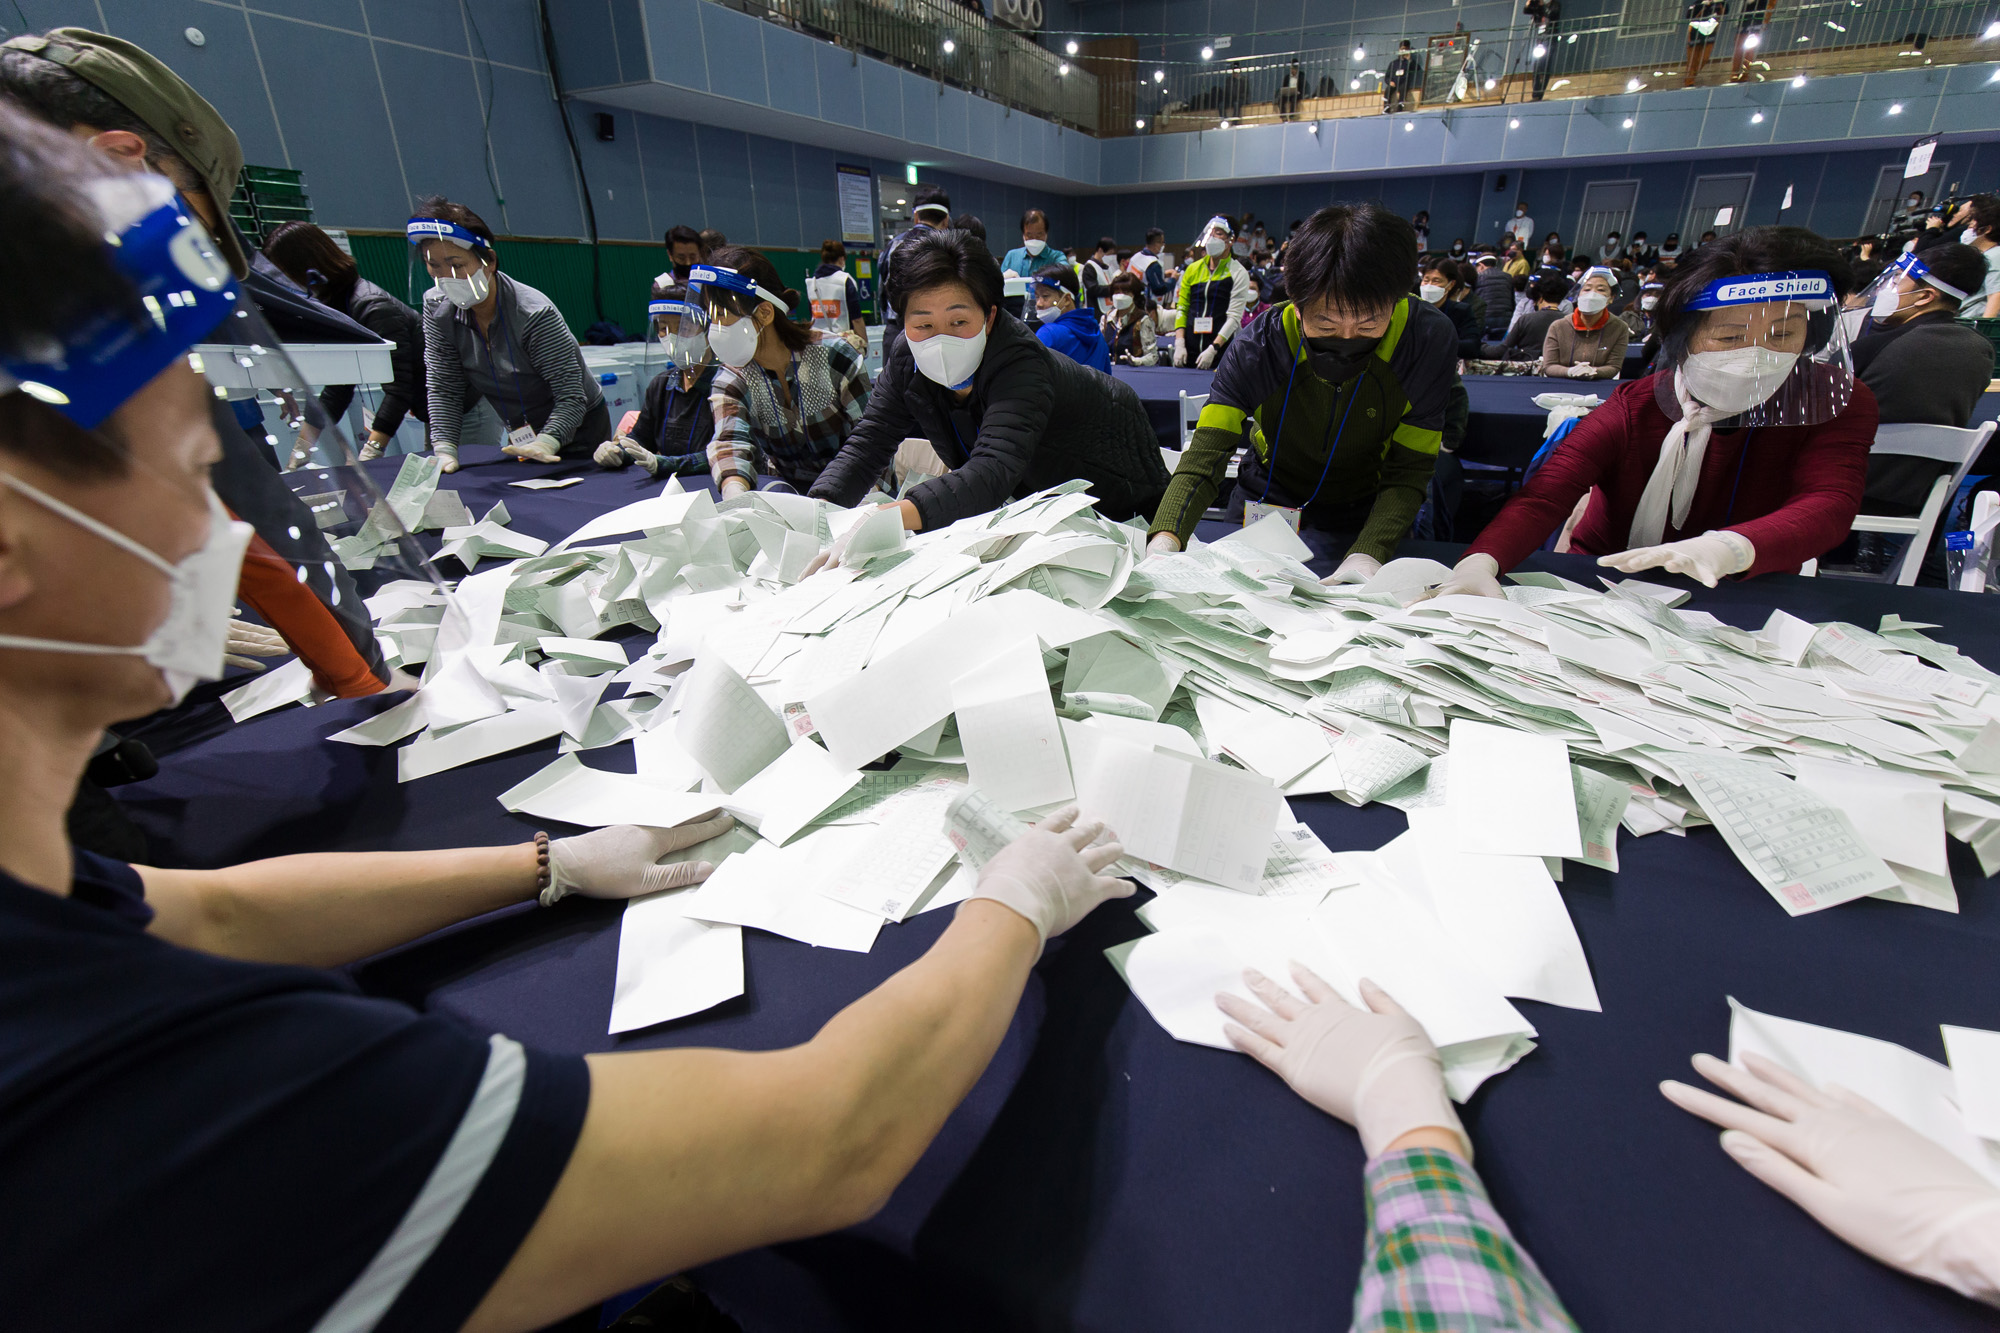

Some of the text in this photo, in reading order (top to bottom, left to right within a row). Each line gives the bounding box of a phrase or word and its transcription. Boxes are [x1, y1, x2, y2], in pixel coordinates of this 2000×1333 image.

[421, 223, 447, 231] Shield
[1728, 280, 1820, 298] Face Shield
[663, 304, 686, 312] Shield
